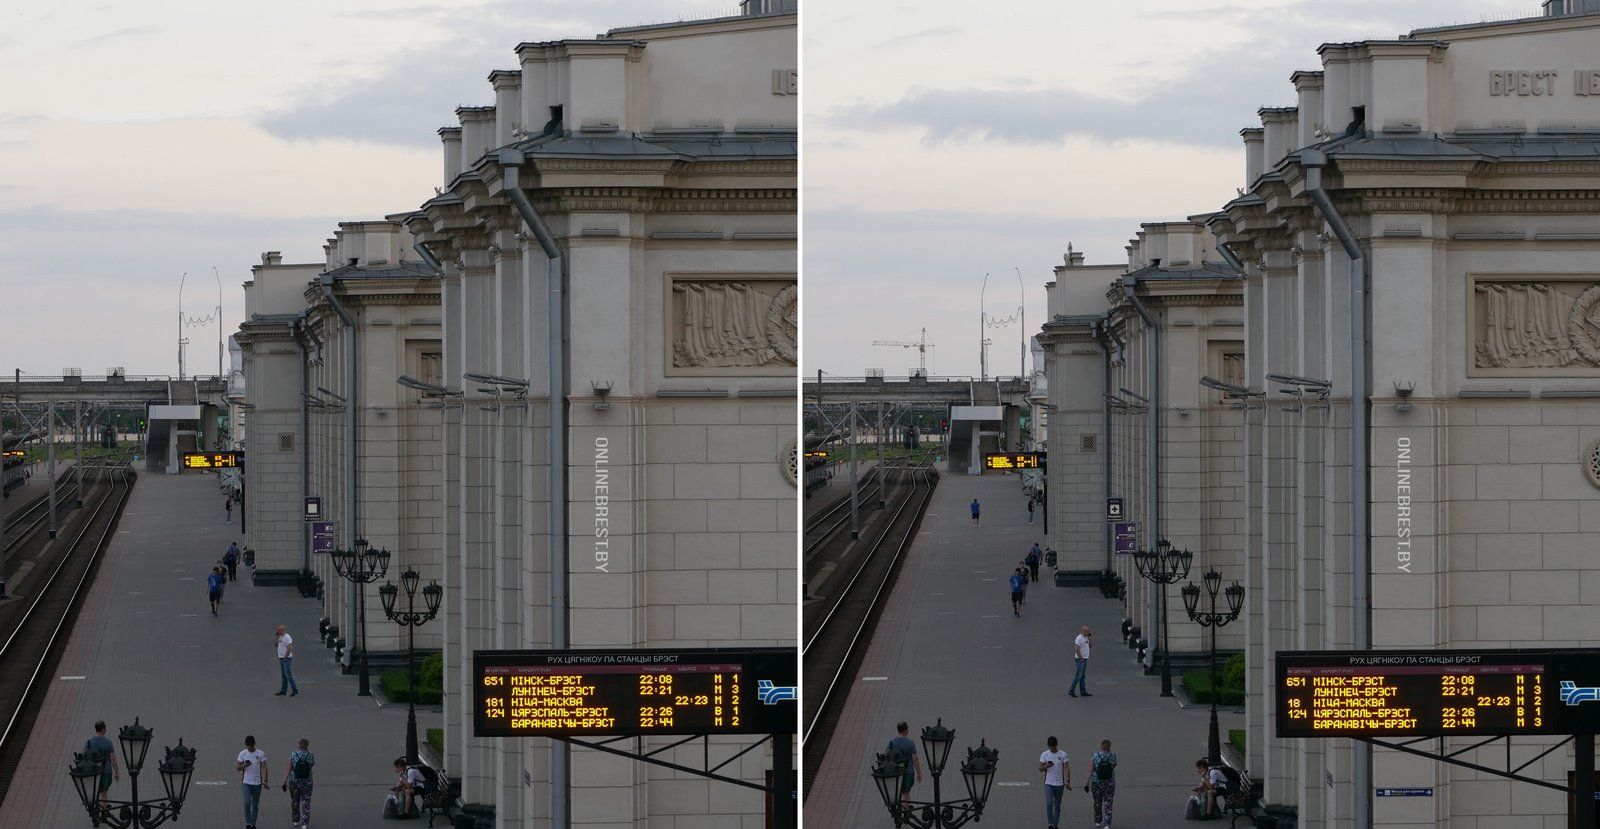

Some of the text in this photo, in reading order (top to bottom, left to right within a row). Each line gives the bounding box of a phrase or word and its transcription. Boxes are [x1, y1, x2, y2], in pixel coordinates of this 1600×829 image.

[1489, 69, 1558, 97] БРЕСТ
[547, 655, 563, 665] РУХ
[604, 655, 615, 664] ПА
[616, 655, 652, 665] СТАНЦЫІ
[653, 655, 679, 664] БРЭСТ
[1349, 657, 1365, 666] РУХ
[1406, 656, 1417, 665] ПА
[1418, 656, 1454, 666] СТАНЦЫІ
[1455, 656, 1481, 665] БРЭСТ
[483, 673, 739, 687] 651 МІНСК-БРЭСТ 22:08 М 1
[1286, 674, 1542, 688] 651 МІНСК-БРЭСТ 22:08 М 1
[511, 684, 740, 697] ЛУНІНЕЦ-БРЭСТ 22:21 М 3
[1313, 684, 1542, 698] ЛУНІНЕЦ-БРЭСТ 22:21 М 3
[485, 694, 740, 708] 181 НІЦА-МАСКВА 22:23 М 2
[1287, 695, 1542, 709] 18 НІЦА-МАСКВА 22:23 М 2
[485, 708, 505, 719] 124
[511, 707, 609, 718] ЦЯРЭСПАЛЬ-БРЭСТ
[639, 706, 673, 717] 22:26
[731, 705, 739, 716] 1
[1287, 708, 1307, 719] 124
[1313, 707, 1411, 719] ЦЯРЭСПАЛЬ-БРЭСТ
[1441, 706, 1476, 717] 22:26
[1534, 706, 1542, 717] 1
[511, 715, 740, 729] БАРАНАВІЧЫ-БРЭСТ 22:44 М 2
[1313, 717, 1542, 730] БАРАНАВІЧЫ-БРЭСТ 22:44 М 3
